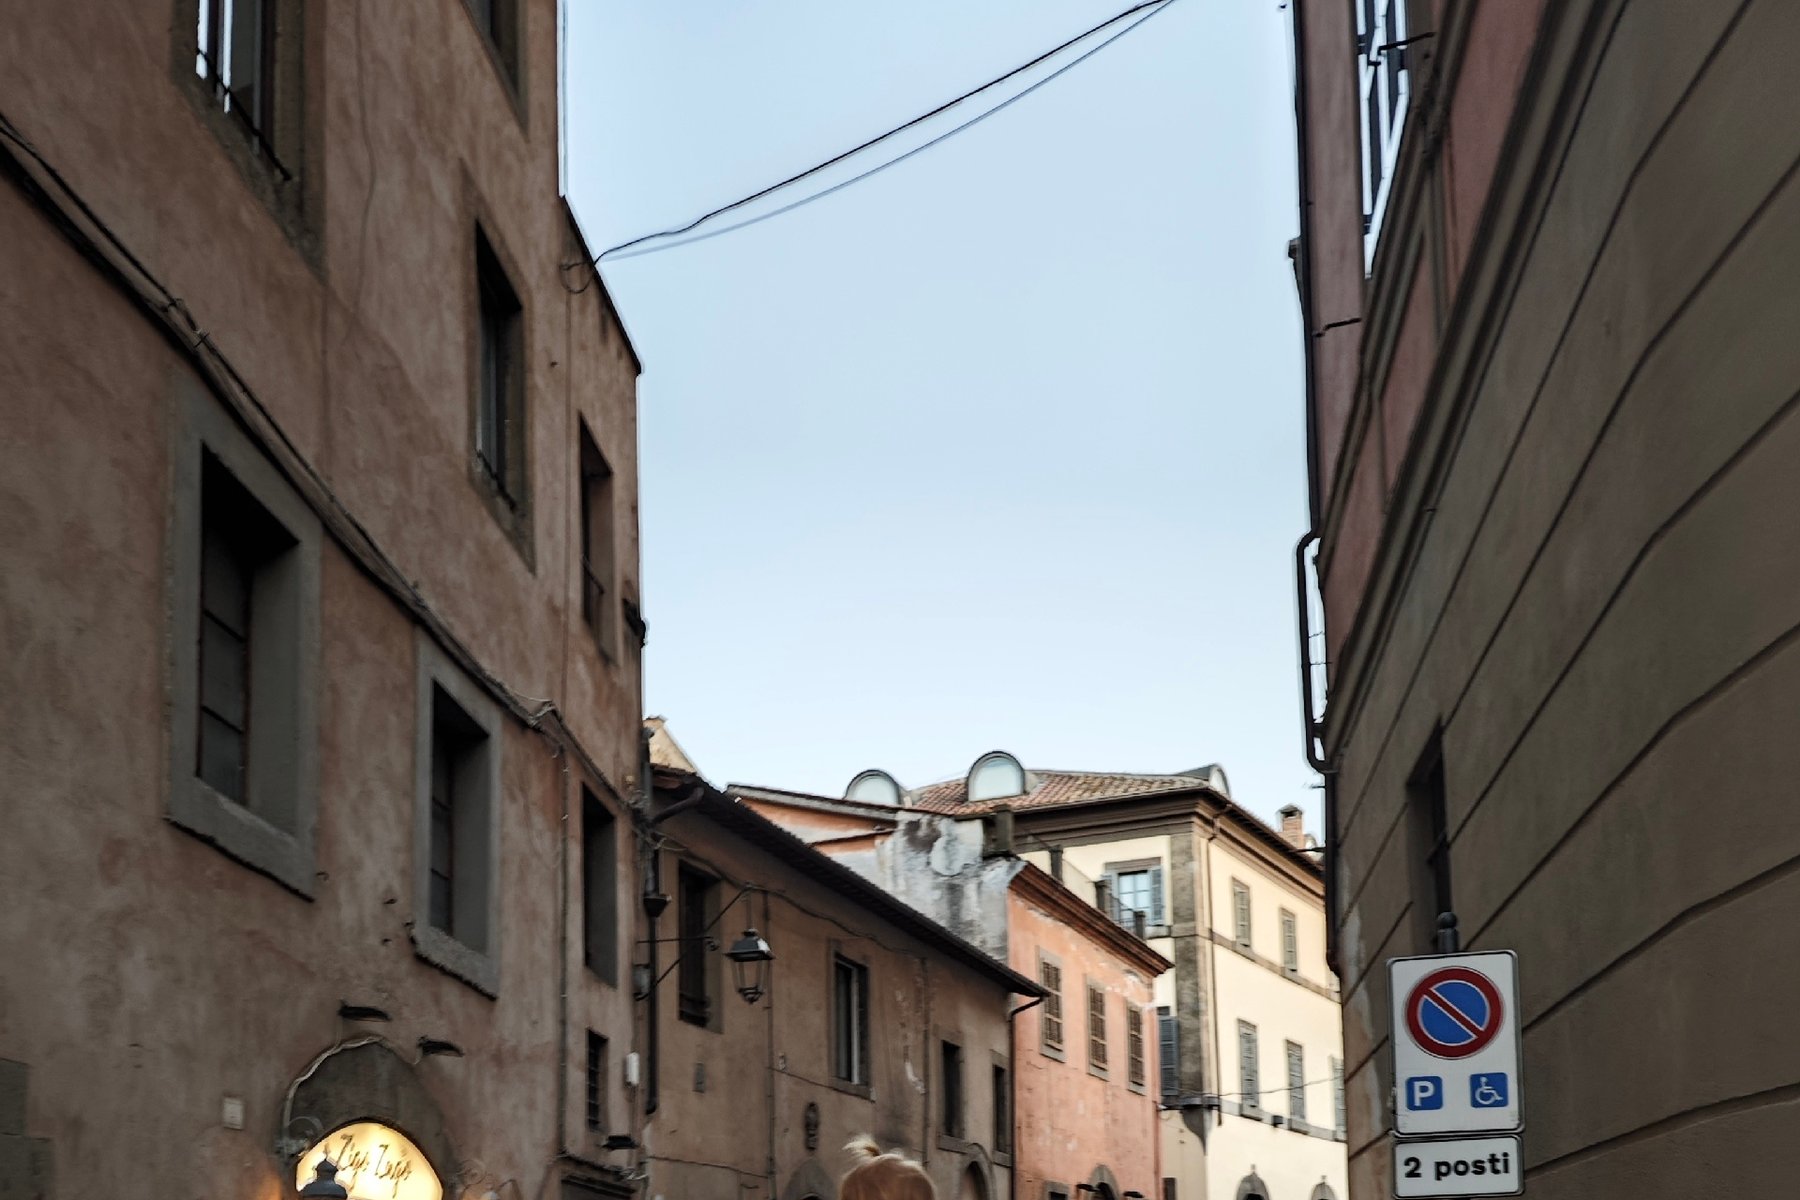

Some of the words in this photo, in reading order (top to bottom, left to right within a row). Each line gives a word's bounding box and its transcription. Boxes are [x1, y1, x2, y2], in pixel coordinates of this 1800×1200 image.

[1413, 1081, 1434, 1106] P
[1404, 1157, 1422, 1179] 2
[1435, 1152, 1510, 1181] posti
